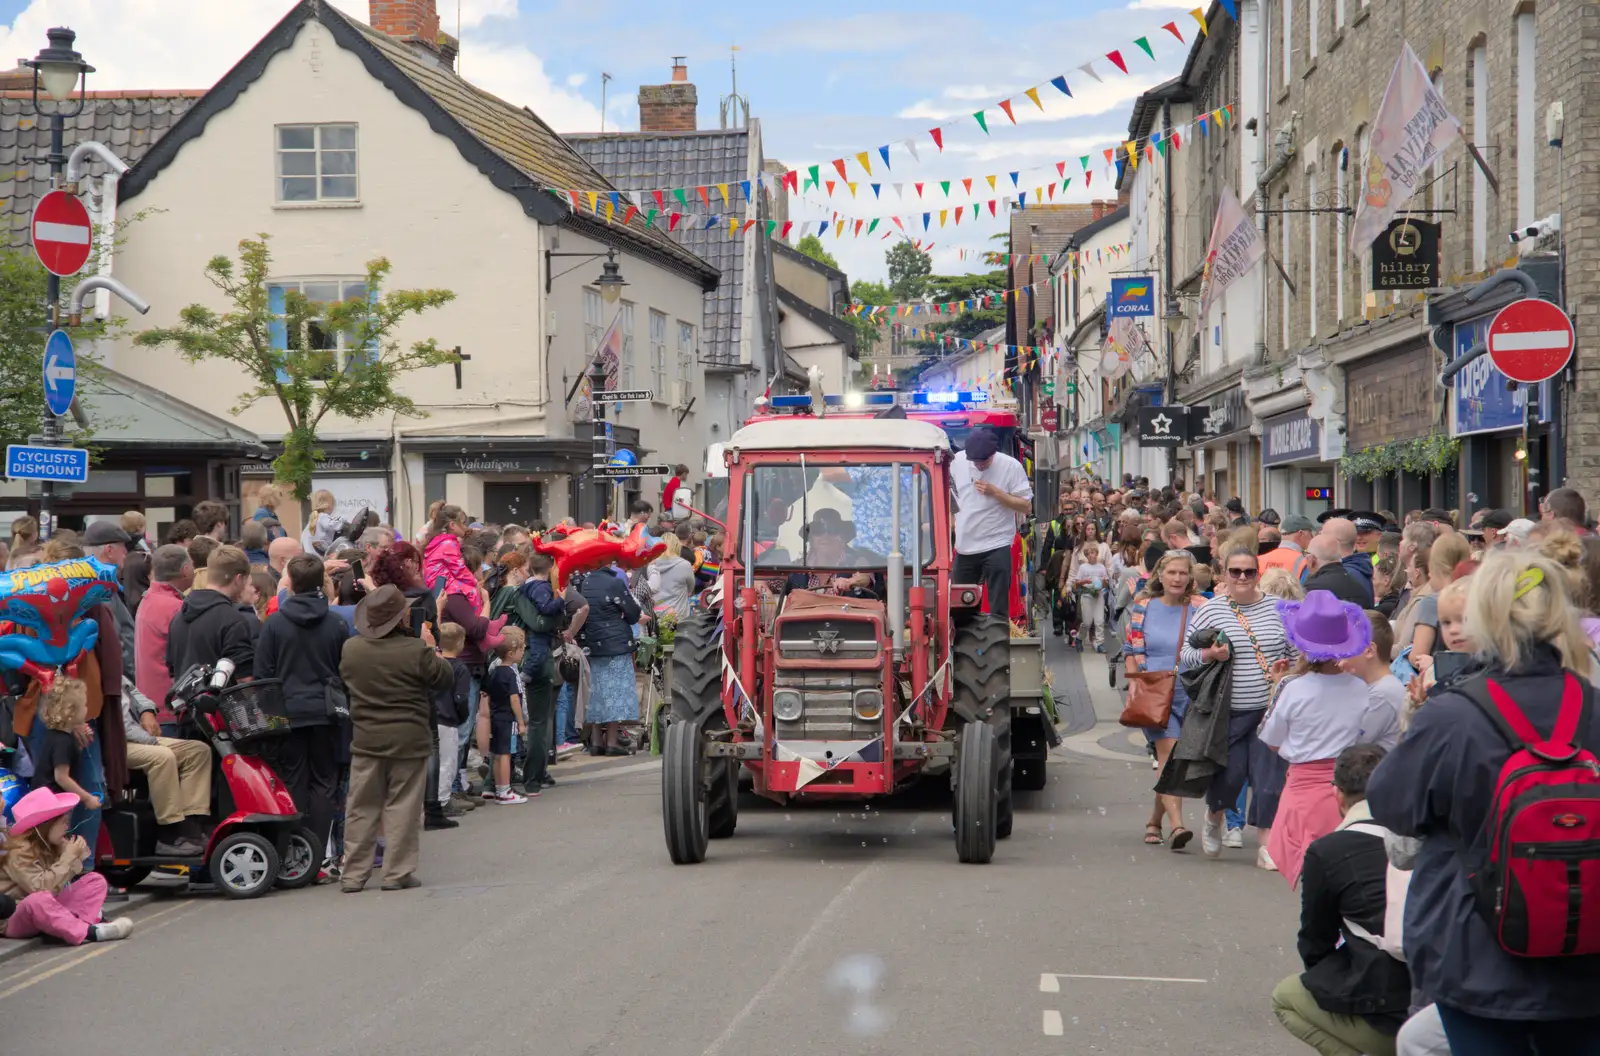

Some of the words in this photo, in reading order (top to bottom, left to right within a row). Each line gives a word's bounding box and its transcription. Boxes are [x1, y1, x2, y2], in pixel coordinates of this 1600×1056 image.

[1380, 262, 1430, 274] hilary
[1381, 274, 1430, 285] &alice
[1117, 304, 1150, 312] CORAL
[1270, 422, 1290, 456] MOBILE
[1290, 418, 1312, 452] ARCADE
[18, 452, 77, 464] CYCLISTS
[13, 463, 82, 476] DISMOUNT
[455, 459, 520, 470] Valuations
[10, 561, 97, 593] SPIDER-MAN
